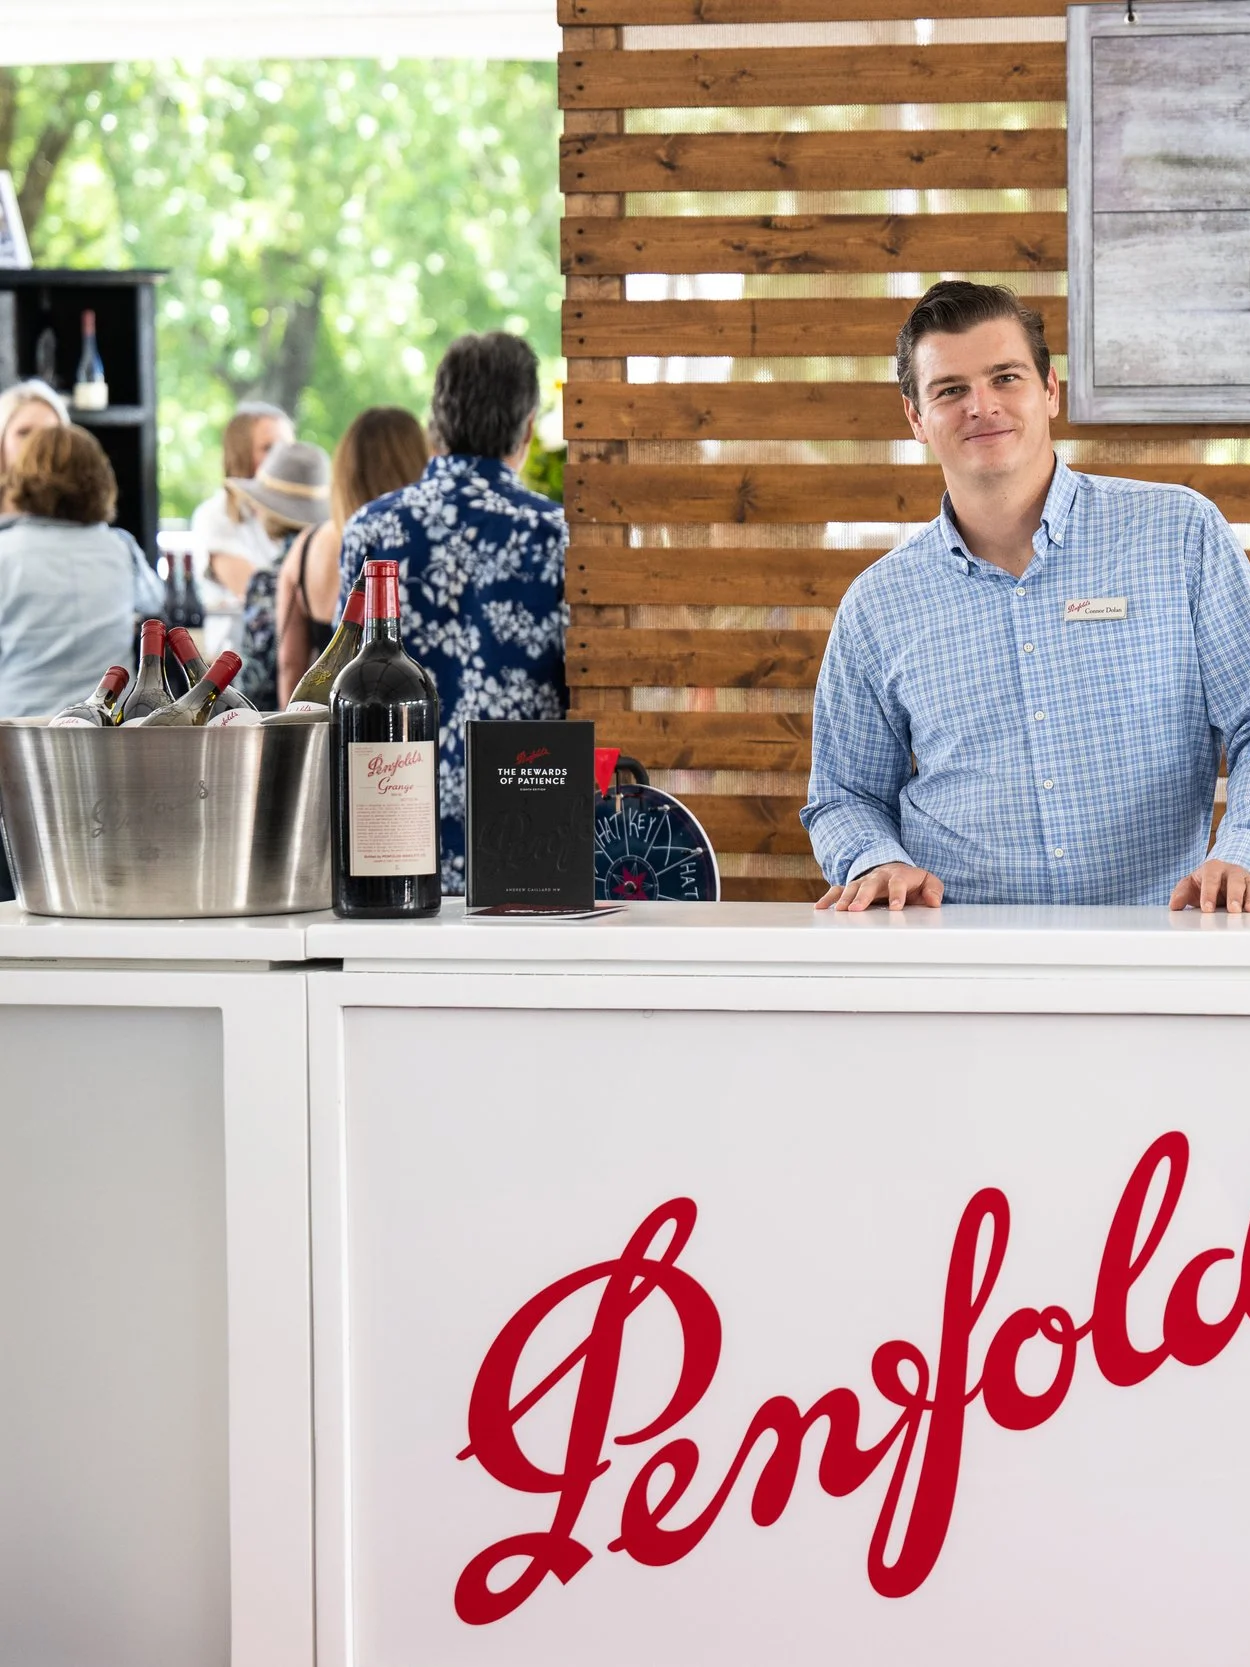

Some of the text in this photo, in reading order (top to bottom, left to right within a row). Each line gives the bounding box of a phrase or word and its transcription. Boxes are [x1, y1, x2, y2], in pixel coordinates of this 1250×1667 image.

[367, 750, 424, 778] Penfolds
[497, 768, 568, 776] THE REWARDS
[377, 775, 414, 795] Grange
[500, 777, 566, 785] OF PATIENCE
[628, 807, 657, 843] KEY
[679, 862, 701, 900] HAT
